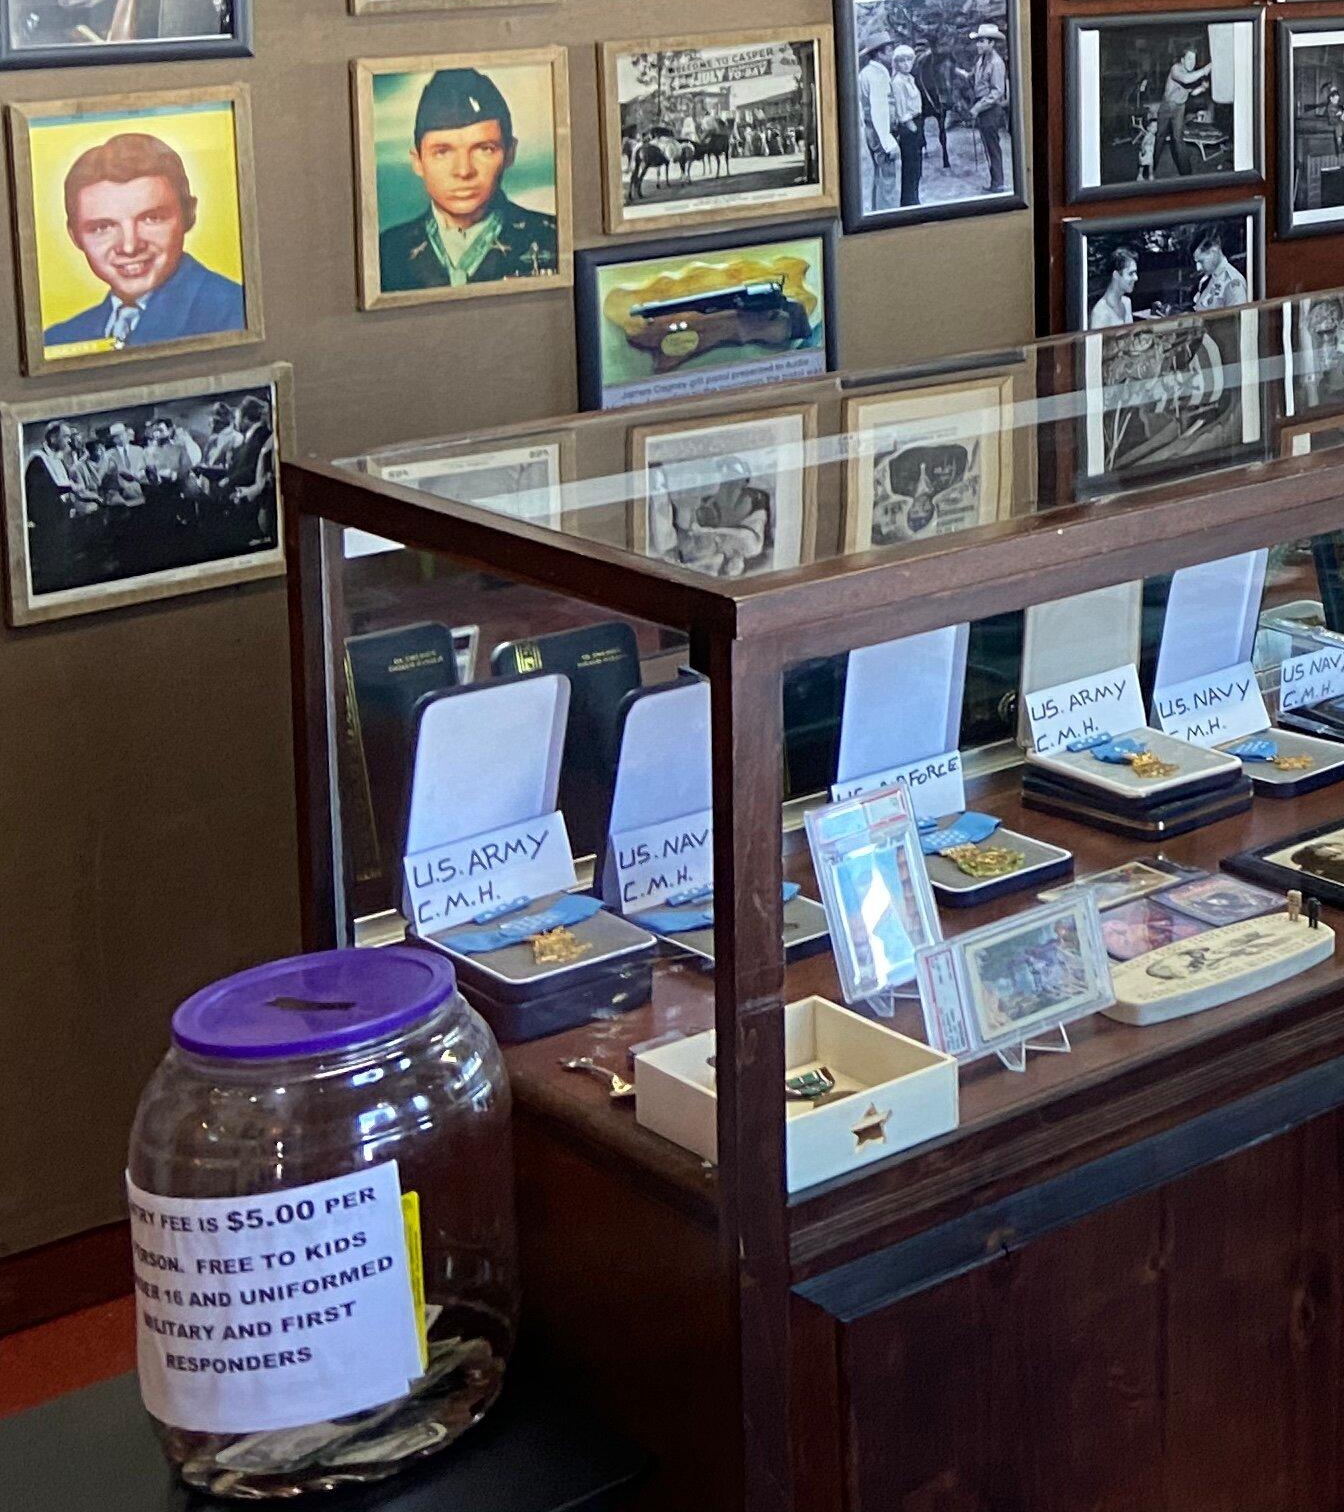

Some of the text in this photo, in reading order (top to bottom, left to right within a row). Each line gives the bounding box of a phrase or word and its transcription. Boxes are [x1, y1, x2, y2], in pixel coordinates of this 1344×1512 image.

[730, 47, 774, 64] CASPER
[1068, 679, 1128, 713] ARMY
[1193, 678, 1250, 710] NAVY
[467, 829, 550, 878] ARMY
[661, 828, 711, 859] NAV
[160, 1214, 193, 1233] FEE
[199, 1216, 220, 1233] IS
[226, 1198, 316, 1234] $5.00
[325, 1186, 378, 1215] PER
[196, 1255, 255, 1276] FREE
[261, 1250, 297, 1271] TO
[304, 1230, 369, 1262] KIDS
[189, 1291, 233, 1309] AND
[239, 1254, 395, 1306] UNIFORMED
[221, 1320, 273, 1341] AND
[281, 1300, 359, 1334] FIRST
[165, 1345, 314, 1376] RESPONDERS
